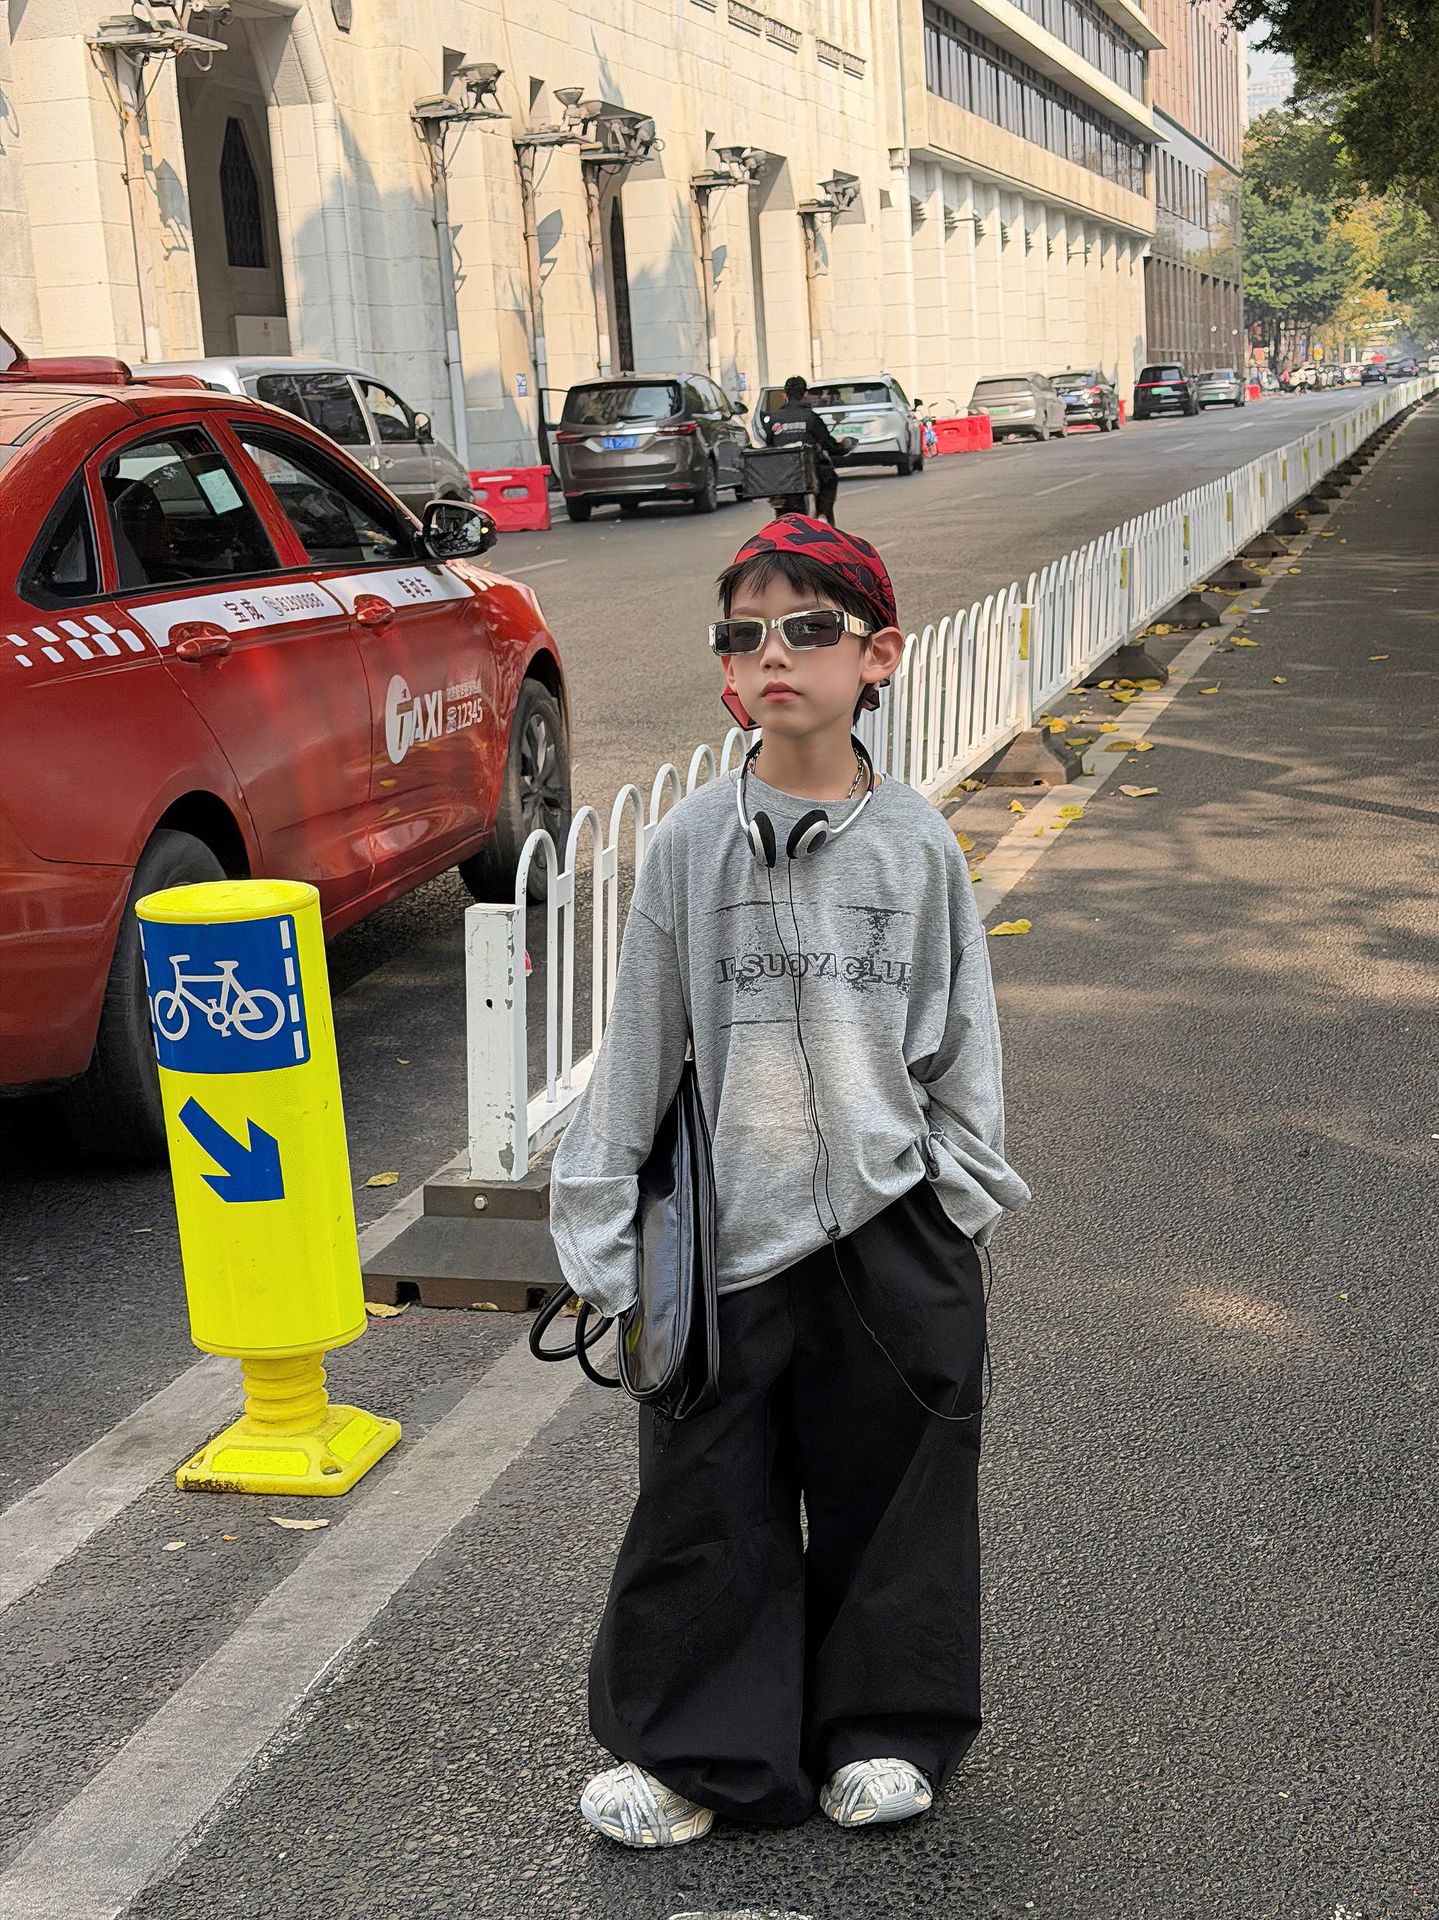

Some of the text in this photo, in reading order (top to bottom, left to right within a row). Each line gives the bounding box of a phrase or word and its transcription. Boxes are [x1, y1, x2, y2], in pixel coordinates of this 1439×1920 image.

[391, 686, 442, 752] TAXI
[457, 698, 483, 730] 12345
[842, 956, 912, 986] CLU
